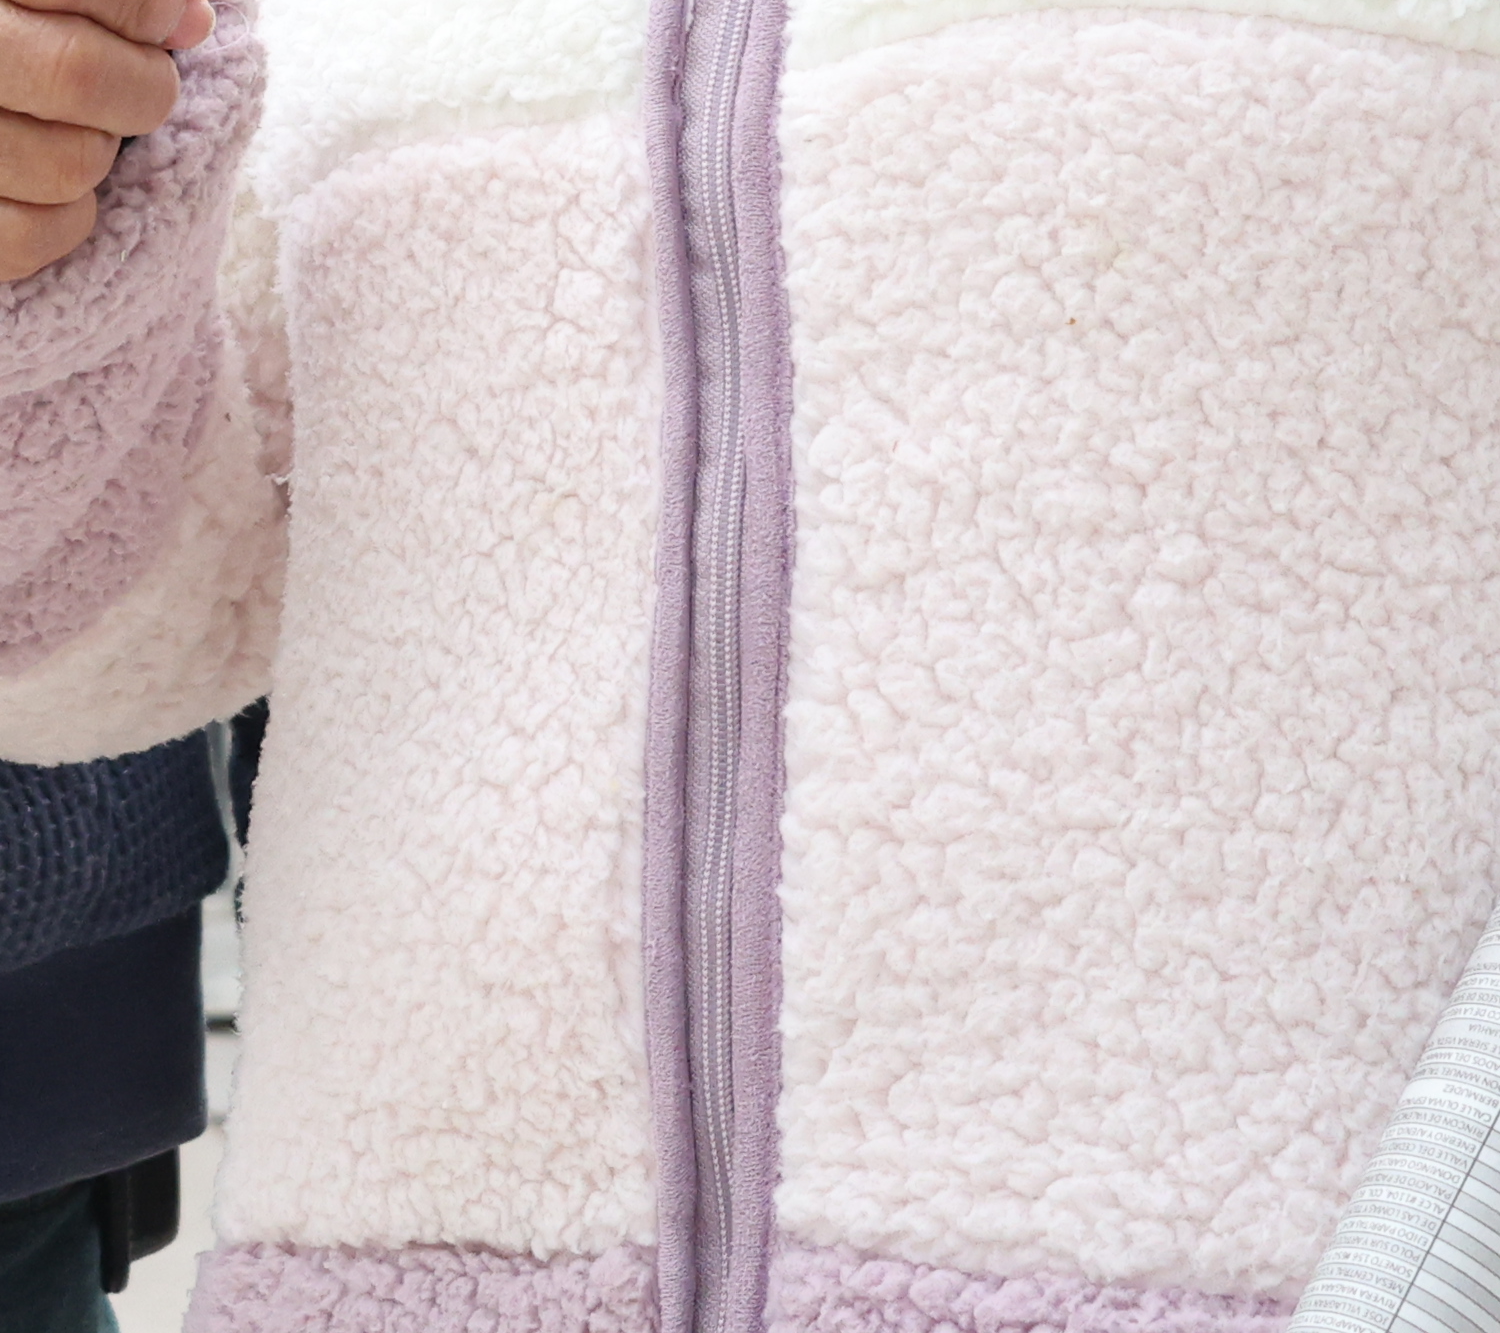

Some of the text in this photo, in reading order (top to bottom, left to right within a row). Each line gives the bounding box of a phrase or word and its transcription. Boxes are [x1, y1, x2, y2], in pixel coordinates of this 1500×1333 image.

[1463, 1007, 1474, 1015] LA
[1474, 1008, 1486, 1017] DE
[1457, 1036, 1489, 1050] SIERRA
[1454, 1051, 1471, 1062] DEL
[1440, 1065, 1480, 1083] MANUEL
[1443, 1082, 1499, 1108] BERMUDEZ
[1428, 1097, 1458, 1110] OLIVIA
[1428, 1113, 1442, 1123] DE
[1459, 1103, 1492, 1122] CALLE
[1426, 1130, 1432, 1138] Y
[1444, 1117, 1483, 1138] RINCON
[1418, 1144, 1435, 1156] DEL
[1433, 1131, 1475, 1153] ENEBRO
[1436, 1149, 1468, 1168] VALLE
[1407, 1159, 1461, 1184] DOMINGO
[1393, 1175, 1406, 1185] DE
[1408, 1177, 1453, 1199] PALACIO
[1368, 1204, 1399, 1218] LOMAS
[1419, 1198, 1445, 1214] ALCE
[1401, 1211, 1419, 1224] LAS
[1421, 1217, 1436, 1230] DE
[1370, 1238, 1388, 1250] SUR
[1396, 1227, 1429, 1247] EJIDO
[1351, 1251, 1368, 1262] 156
[1389, 1243, 1419, 1262] POLO
[1336, 1266, 1373, 1282] CENTRAL
[1369, 1255, 1412, 1279] SONETO
[1374, 1274, 1404, 1294] MESA
[1358, 1288, 1395, 1309] RIVERA
[1364, 1309, 1390, 1326] JOSE
